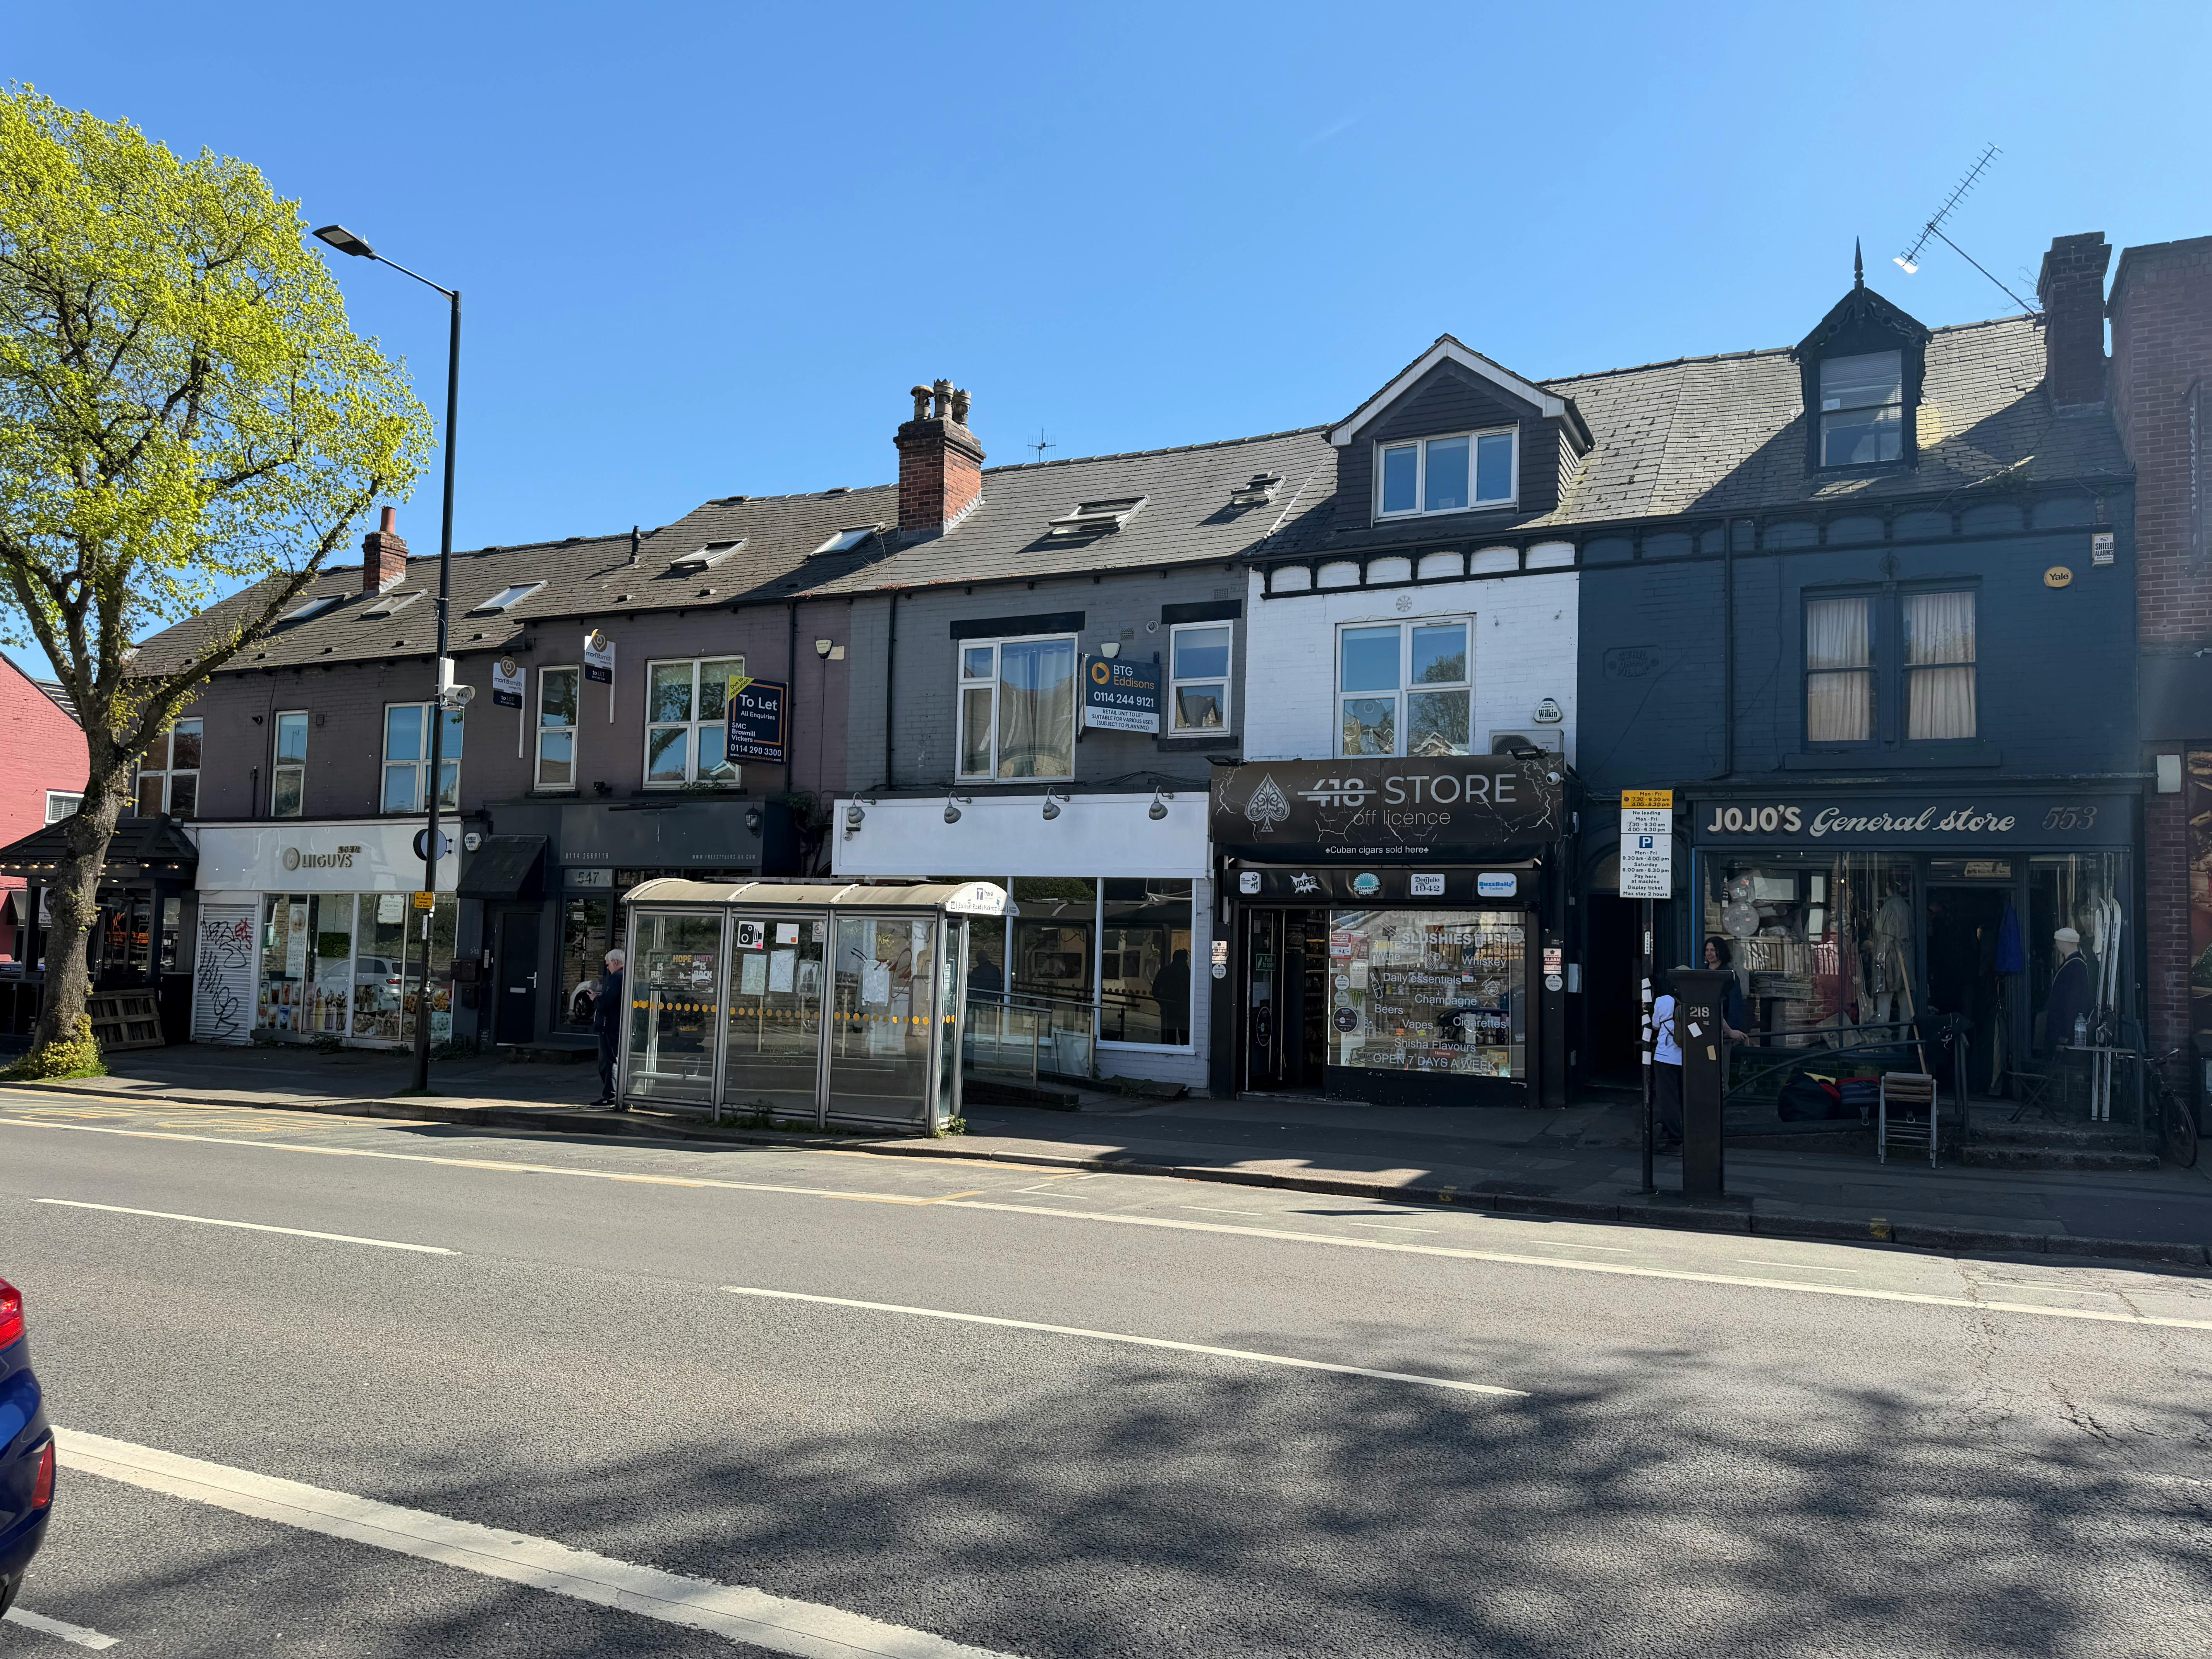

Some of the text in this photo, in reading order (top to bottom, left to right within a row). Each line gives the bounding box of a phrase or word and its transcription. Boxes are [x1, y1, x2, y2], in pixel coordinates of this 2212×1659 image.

[2095, 542, 2113, 550] SHIELD
[1617, 651, 1648, 660] CYRIL
[1620, 659, 1644, 668] 1899
[1114, 665, 1133, 676] BTG
[1617, 667, 1646, 677] VILLA
[730, 678, 750, 696] relocation
[1114, 676, 1154, 690] Eddisons
[739, 694, 777, 711] To Let
[1094, 691, 1154, 707] 0114 244 9121
[750, 712, 775, 720] Enquiries
[1539, 709, 1557, 718] Wilkin
[732, 728, 756, 737] Brownill
[731, 744, 781, 756] 0114 290 3300
[1305, 773, 1516, 807] 418 STORE
[1354, 809, 1451, 825] off licence
[1707, 804, 2097, 837] JOJO'S General store 553
[1642, 837, 1651, 848] P
[1330, 845, 1356, 854] Cuban
[1358, 846, 1383, 855] cigars
[577, 871, 599, 884] 547
[1250, 874, 1258, 890] 白州
[1293, 877, 1317, 889] VAPES
[1402, 933, 1472, 945] SLUSHIES
[673, 955, 692, 963] HOPE
[1375, 950, 1506, 969] Wine Whiskey
[1383, 972, 1462, 985] Daily essentials
[1415, 994, 1477, 1007] Champagne
[1375, 1004, 1403, 1014] Beers
[1402, 1019, 1434, 1030] Vapes
[1453, 1017, 1507, 1029] Cigarettes
[1394, 1038, 1476, 1053] Shisha Flavours
[1373, 1053, 1496, 1071] OPEN 7 DAYS A WEEK
